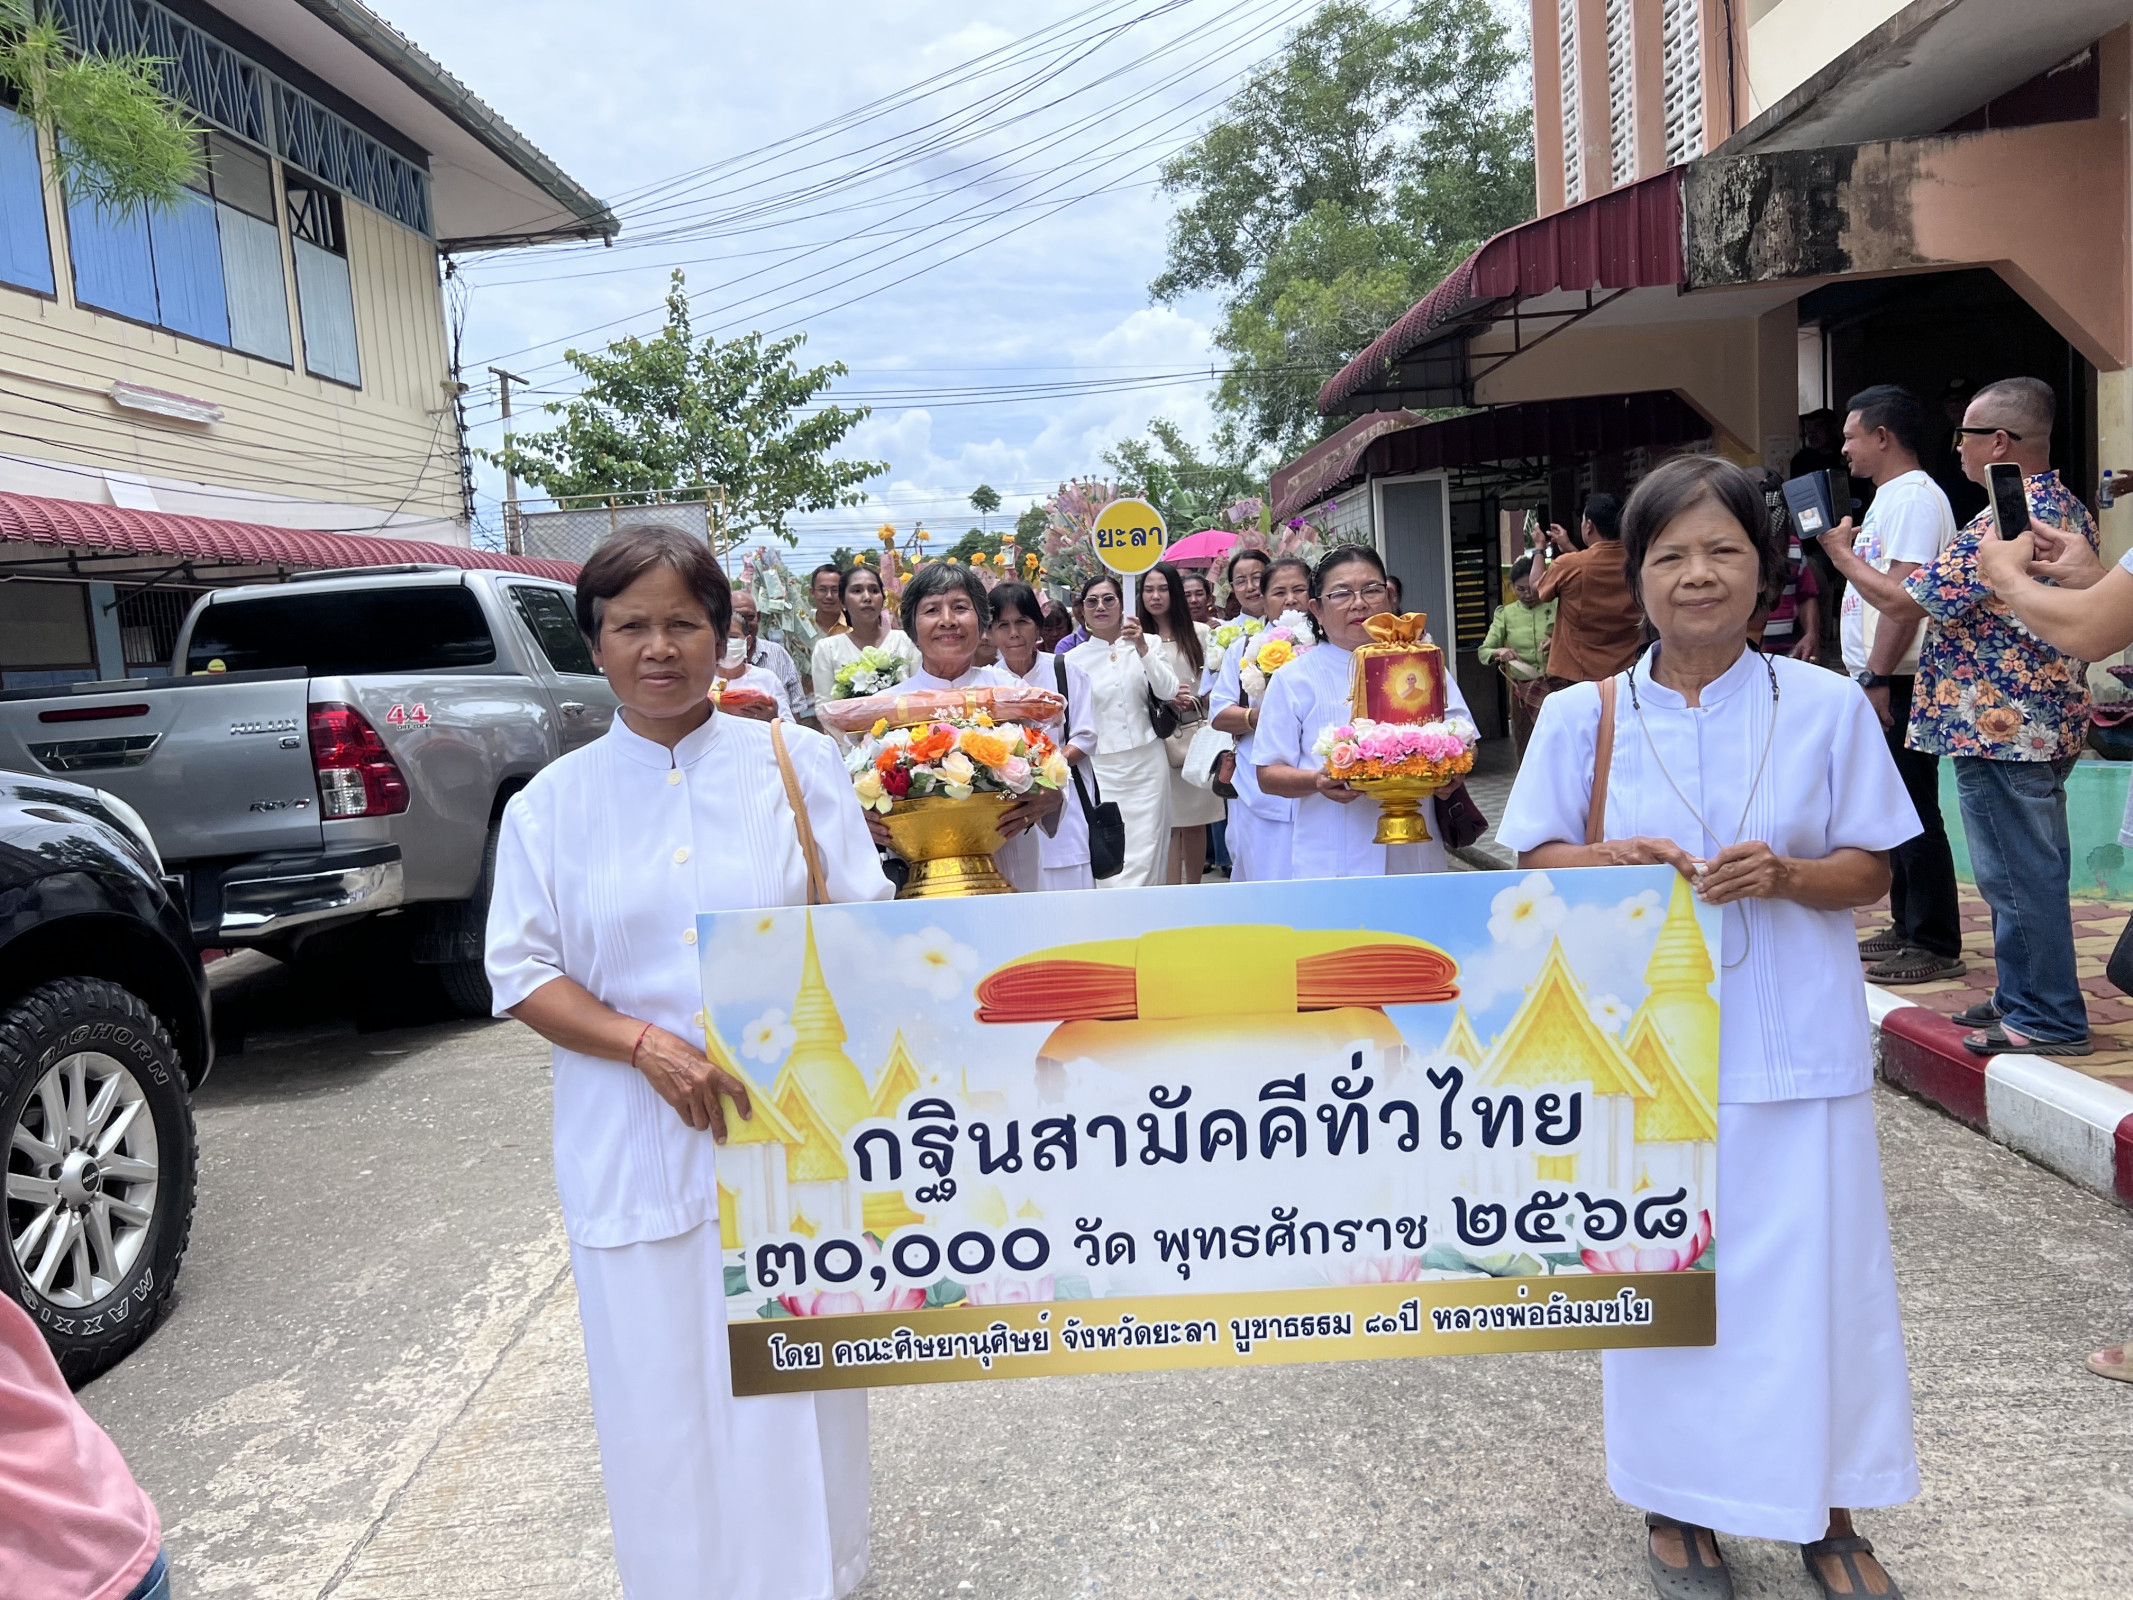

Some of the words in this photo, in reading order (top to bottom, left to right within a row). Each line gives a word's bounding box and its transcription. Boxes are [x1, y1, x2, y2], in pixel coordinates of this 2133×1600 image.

[1096, 526, 1163, 548] ยะลา
[230, 719, 299, 735] HILUX
[37, 1023, 169, 1086] BIGHORN
[853, 1050, 1583, 1203] กฐินสามัคคีทั่วไทย
[755, 1227, 1051, 1292] ๓๐,๐๐๐
[1073, 1216, 1136, 1266] วัด
[1153, 1206, 1428, 1281] พุทธศักราช
[1451, 1186, 1688, 1248] ๒๕๖๘
[20, 1267, 154, 1336] MAXXIS
[770, 1335, 821, 1367] โดย
[835, 1312, 1049, 1366] คณะศิษยานุศิษย์
[1062, 1315, 1217, 1349] จังหวัดยะลา
[1231, 1313, 1352, 1353] บูชาธรรม
[1365, 1299, 1419, 1333] ๘๑ปี
[1433, 1287, 1650, 1330] หลวงพ่อธัมมชโย
